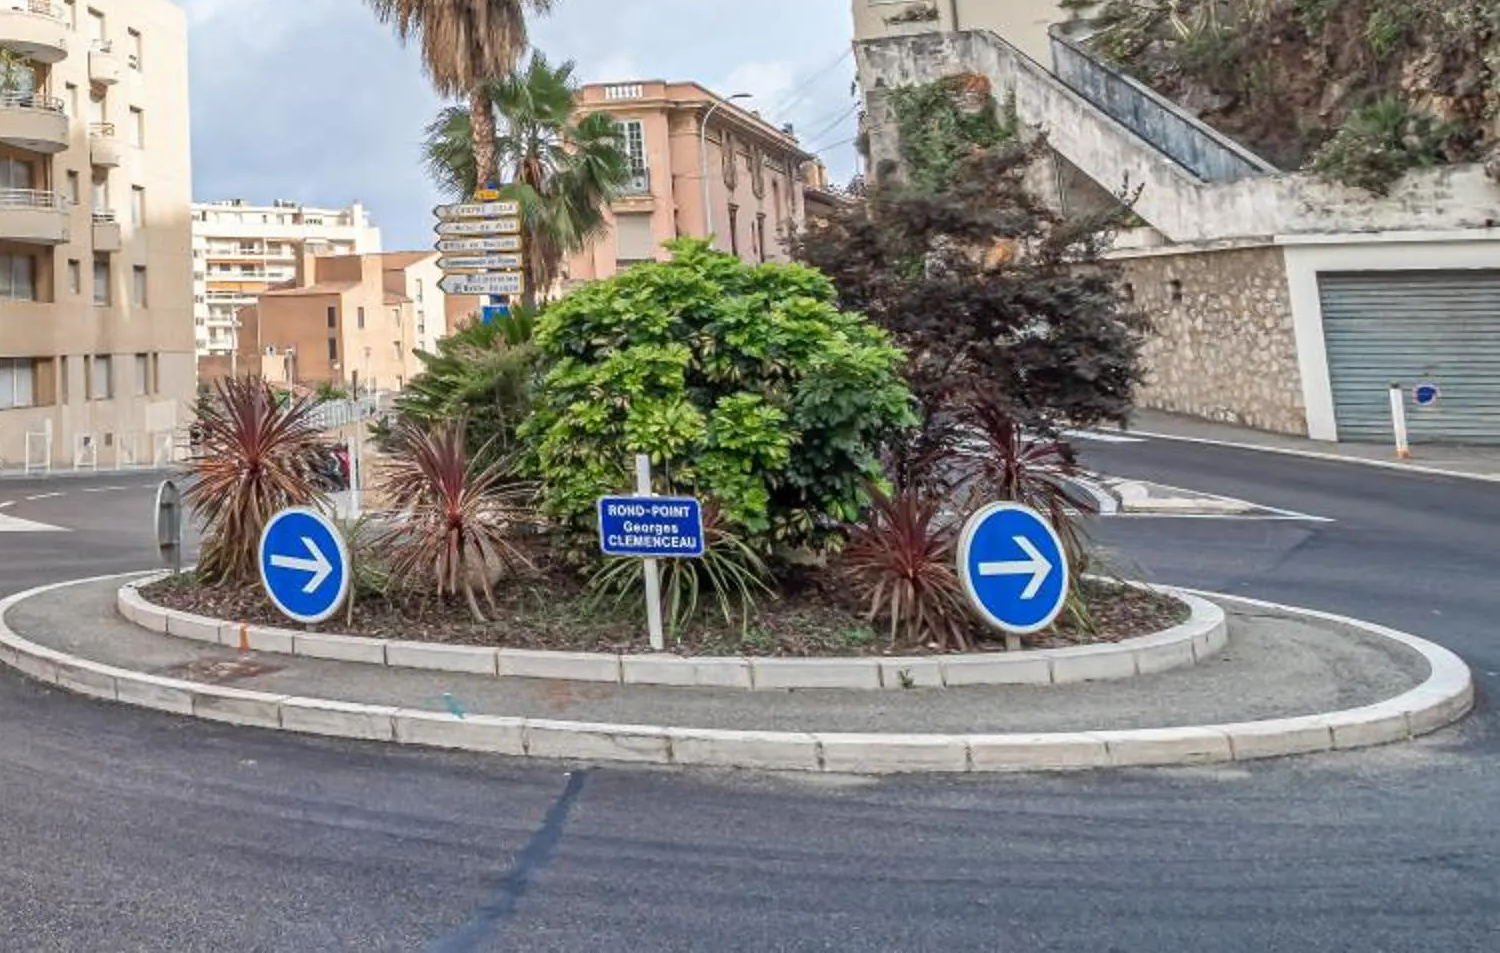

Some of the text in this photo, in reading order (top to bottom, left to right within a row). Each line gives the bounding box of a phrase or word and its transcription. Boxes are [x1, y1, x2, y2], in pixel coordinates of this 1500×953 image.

[607, 504, 690, 518] ROND-POINT
[623, 520, 679, 535] Georges
[607, 534, 697, 548] CLEMENCEAU
